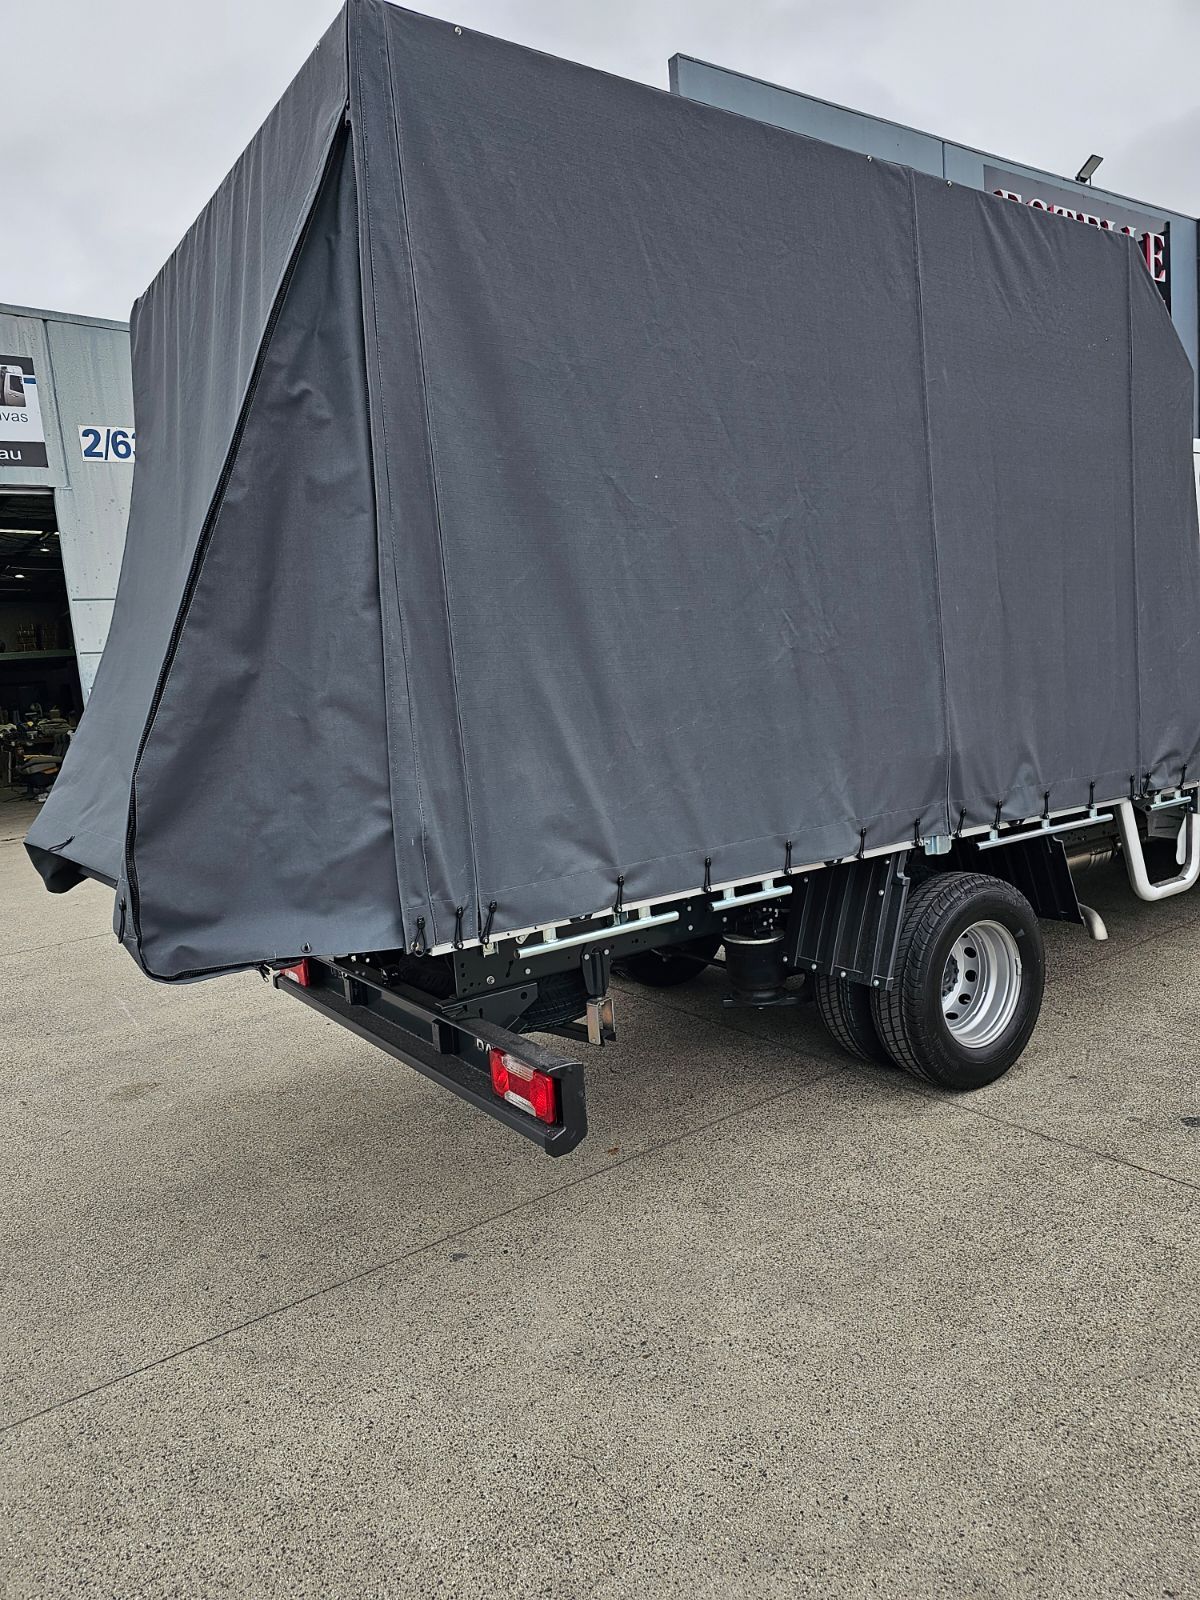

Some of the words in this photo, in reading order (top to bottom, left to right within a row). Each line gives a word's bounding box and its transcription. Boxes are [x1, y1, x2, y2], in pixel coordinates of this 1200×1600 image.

[0, 411, 29, 423] vas
[82, 428, 135, 460] 2/6
[476, 1038, 495, 1054] DA
